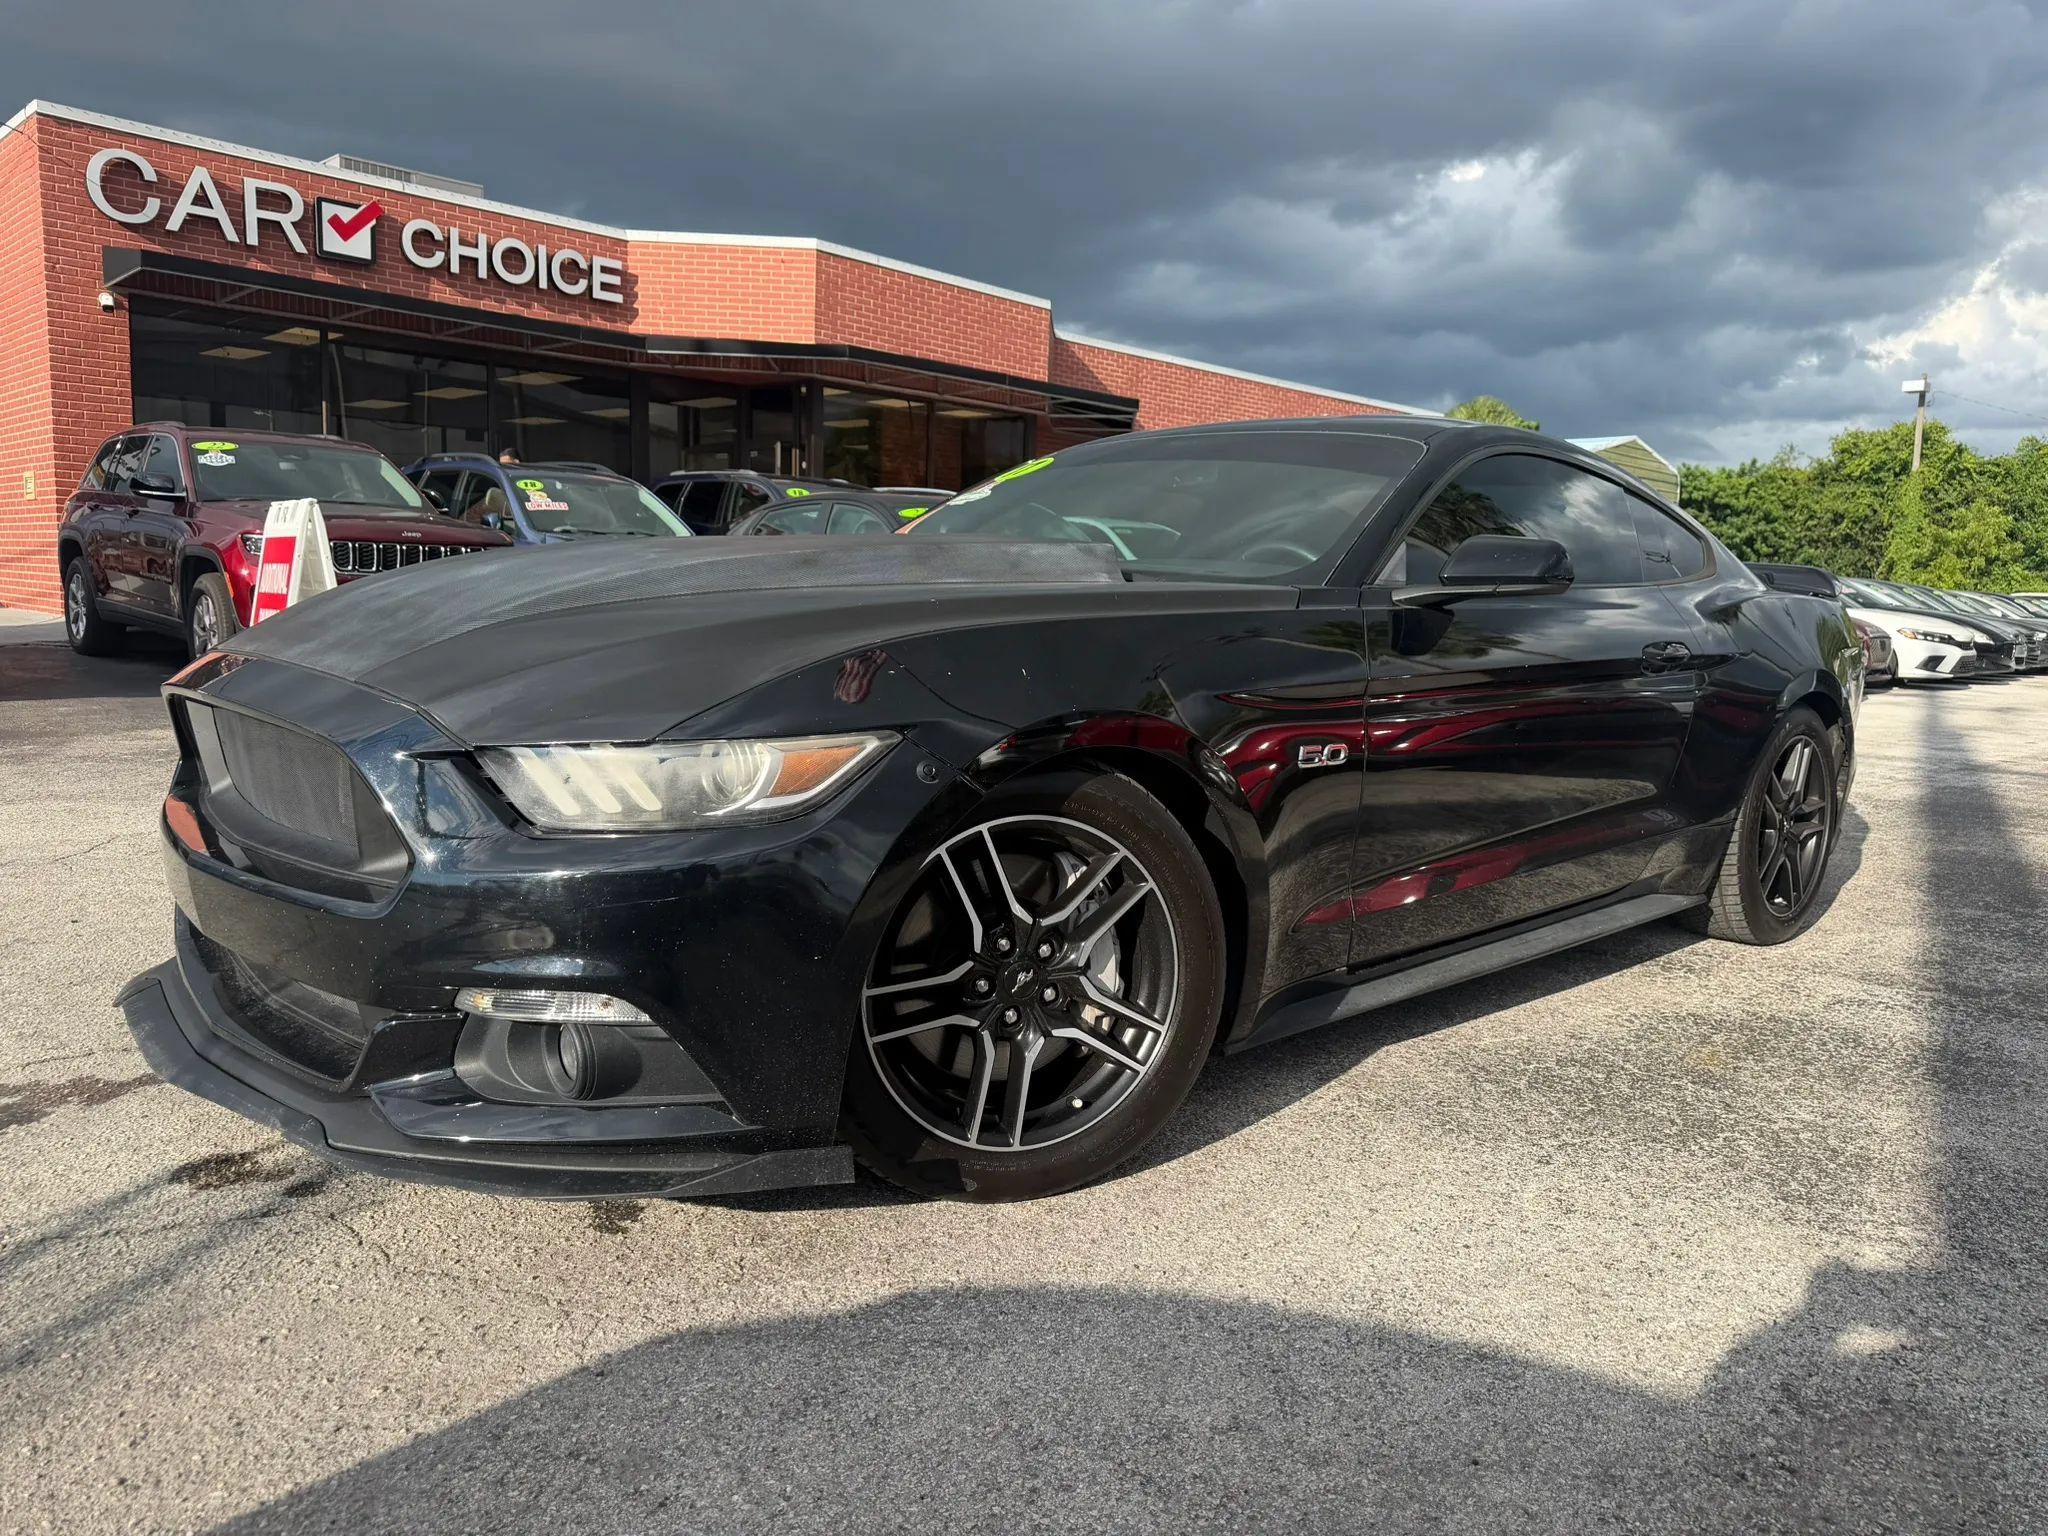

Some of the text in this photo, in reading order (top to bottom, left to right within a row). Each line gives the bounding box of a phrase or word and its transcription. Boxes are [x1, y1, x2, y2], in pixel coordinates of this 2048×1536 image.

[86, 148, 625, 304] CAR CHOICE
[401, 530, 422, 538] Jeep
[1298, 743, 1349, 768] 5.0
